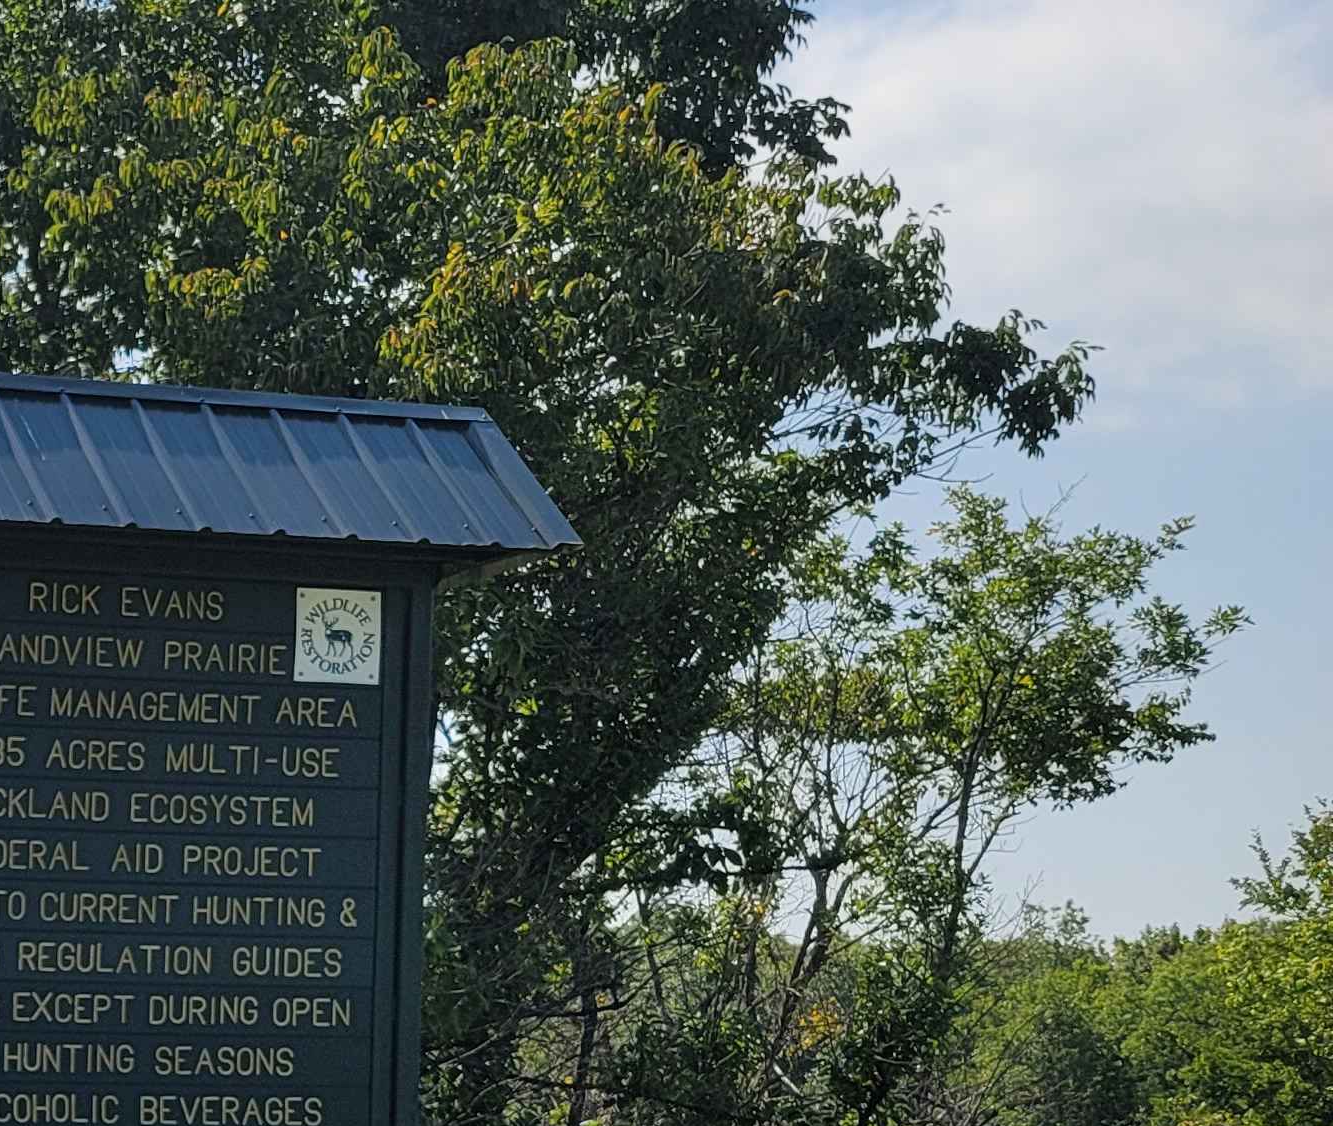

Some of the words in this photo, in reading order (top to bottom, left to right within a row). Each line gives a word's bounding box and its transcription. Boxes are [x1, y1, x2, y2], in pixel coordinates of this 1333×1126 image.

[29, 581, 101, 615] RICK
[120, 585, 224, 622] EVANS
[305, 598, 372, 626] WILDLIFE
[164, 640, 287, 676] PRAIRIE
[300, 628, 376, 675] RESTORATION
[49, 686, 261, 725] MANAGEMENT
[276, 697, 358, 728] AREA
[46, 739, 144, 772] ACRES
[165, 745, 340, 779] MULTI-USE
[130, 793, 314, 827] ECOSYSTEM
[111, 844, 163, 874] AID
[183, 845, 322, 879] PROJECT
[39, 892, 178, 925] CURRENT
[192, 895, 325, 927] HUNTING
[339, 898, 358, 928] &
[17, 942, 212, 976] REGULATION
[232, 946, 342, 978] GUIDES
[12, 993, 135, 1025] EXCEPT
[148, 996, 258, 1027] DURING
[272, 998, 351, 1027] OPEN
[3, 1043, 134, 1075] HUNTING
[154, 1045, 294, 1076] SEASONS
[140, 1096, 323, 1126] BEVERAGES
